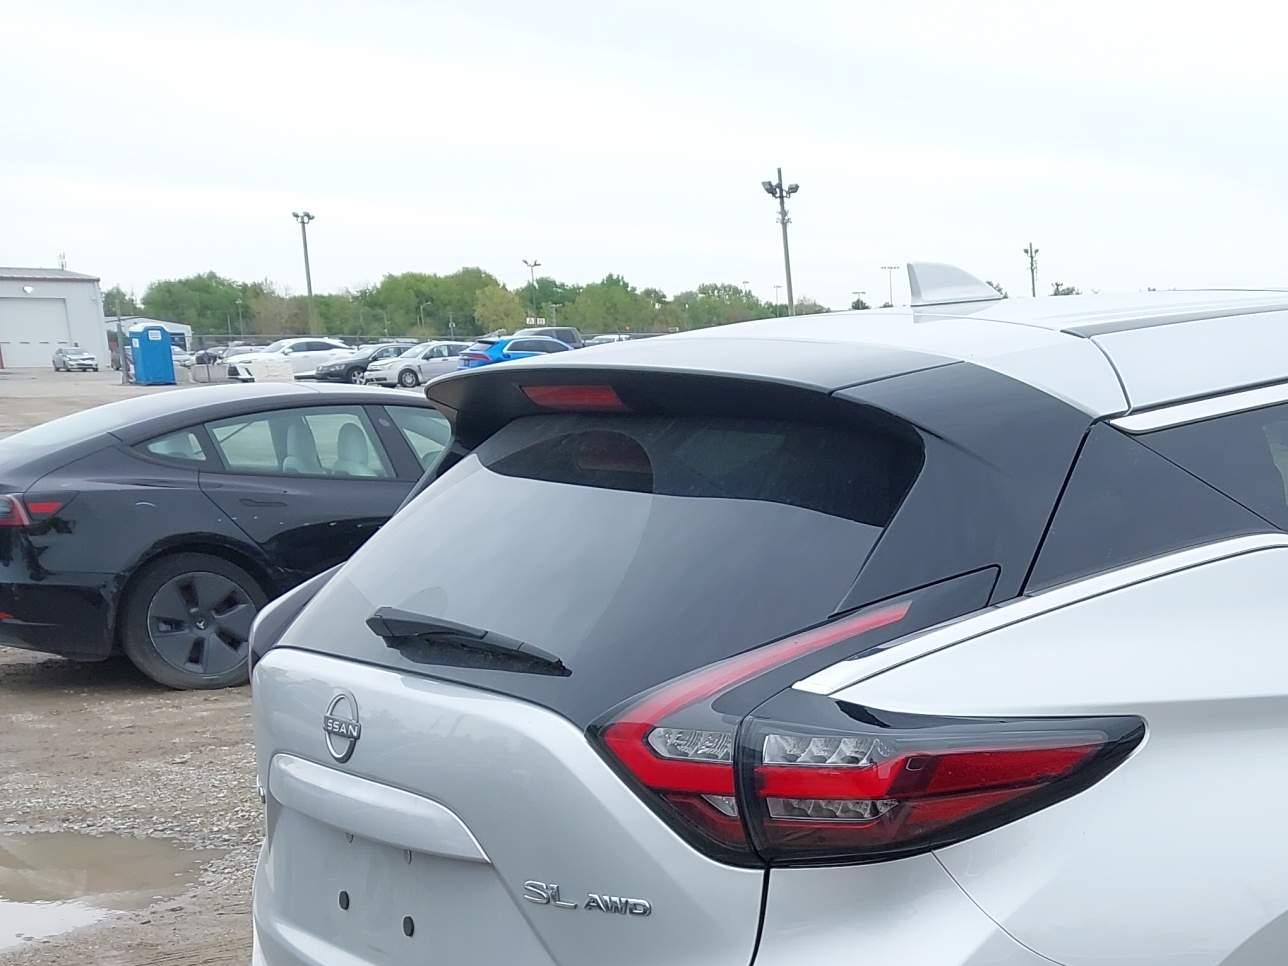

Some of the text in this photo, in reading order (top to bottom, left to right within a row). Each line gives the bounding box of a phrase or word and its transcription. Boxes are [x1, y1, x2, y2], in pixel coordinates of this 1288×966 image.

[325, 718, 359, 737] SSAN
[523, 880, 652, 916] SL AWD
